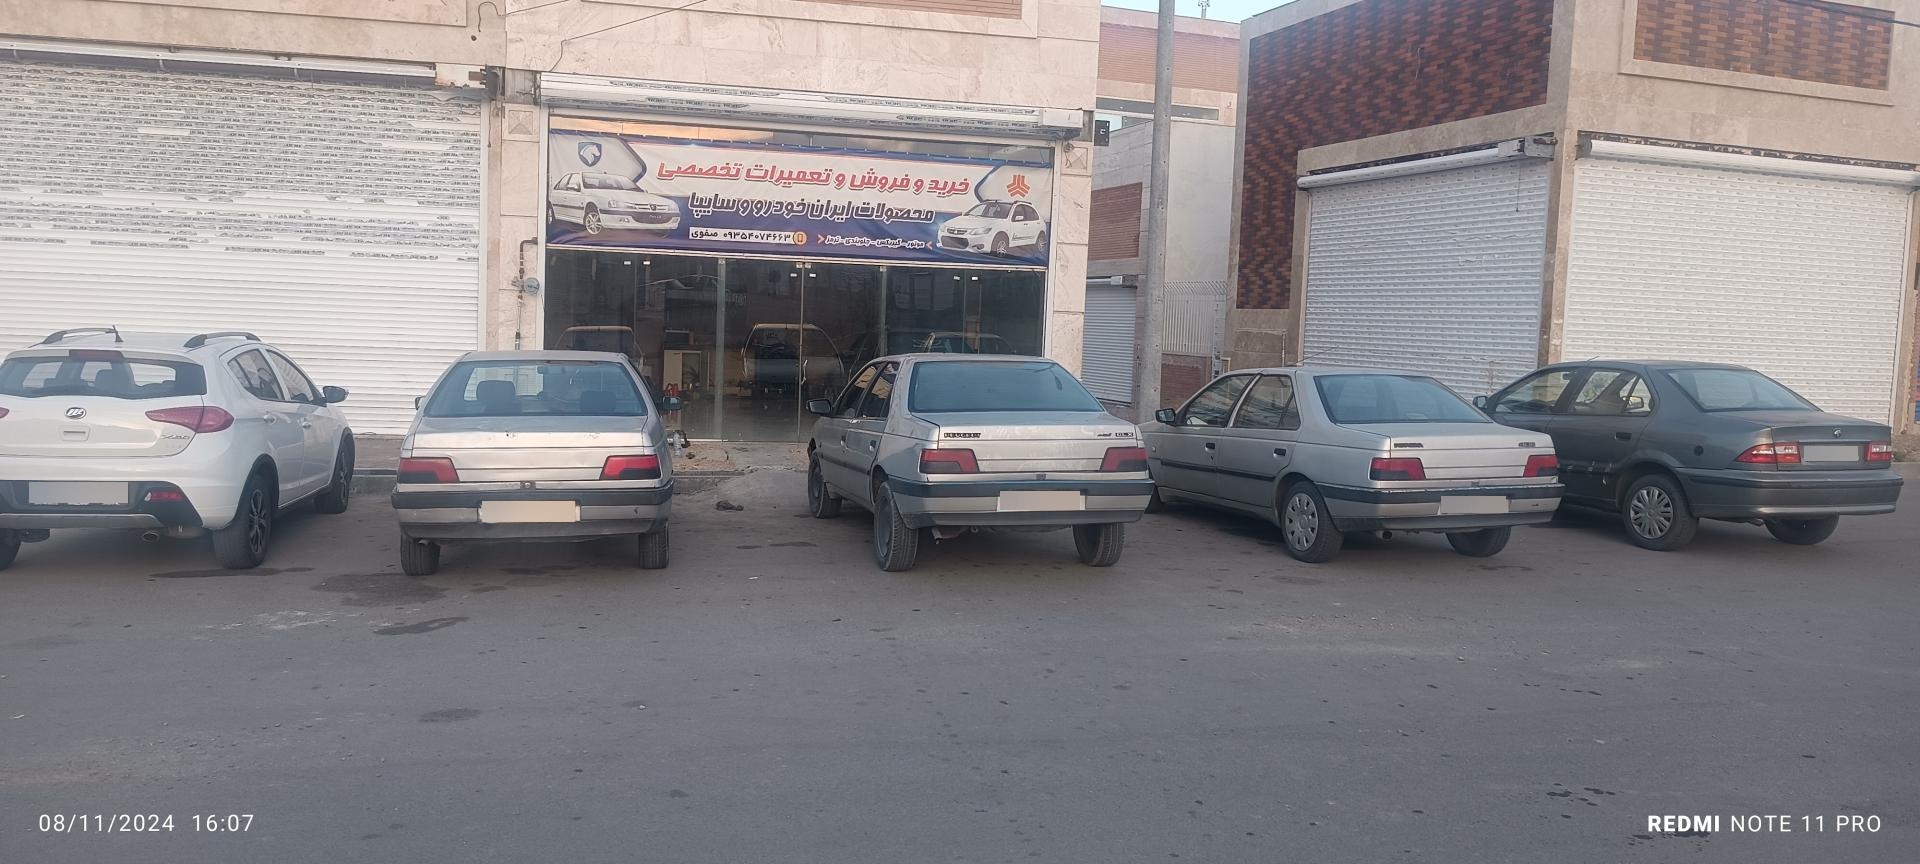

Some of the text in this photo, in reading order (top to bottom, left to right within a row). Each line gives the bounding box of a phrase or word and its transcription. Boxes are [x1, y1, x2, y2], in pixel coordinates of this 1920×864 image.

[656, 162, 970, 197] خرید و فروش و تعمیرات تخصصی
[688, 192, 936, 224] محصولات ایران خودرو و سایپا
[691, 229, 718, 239] صفوی
